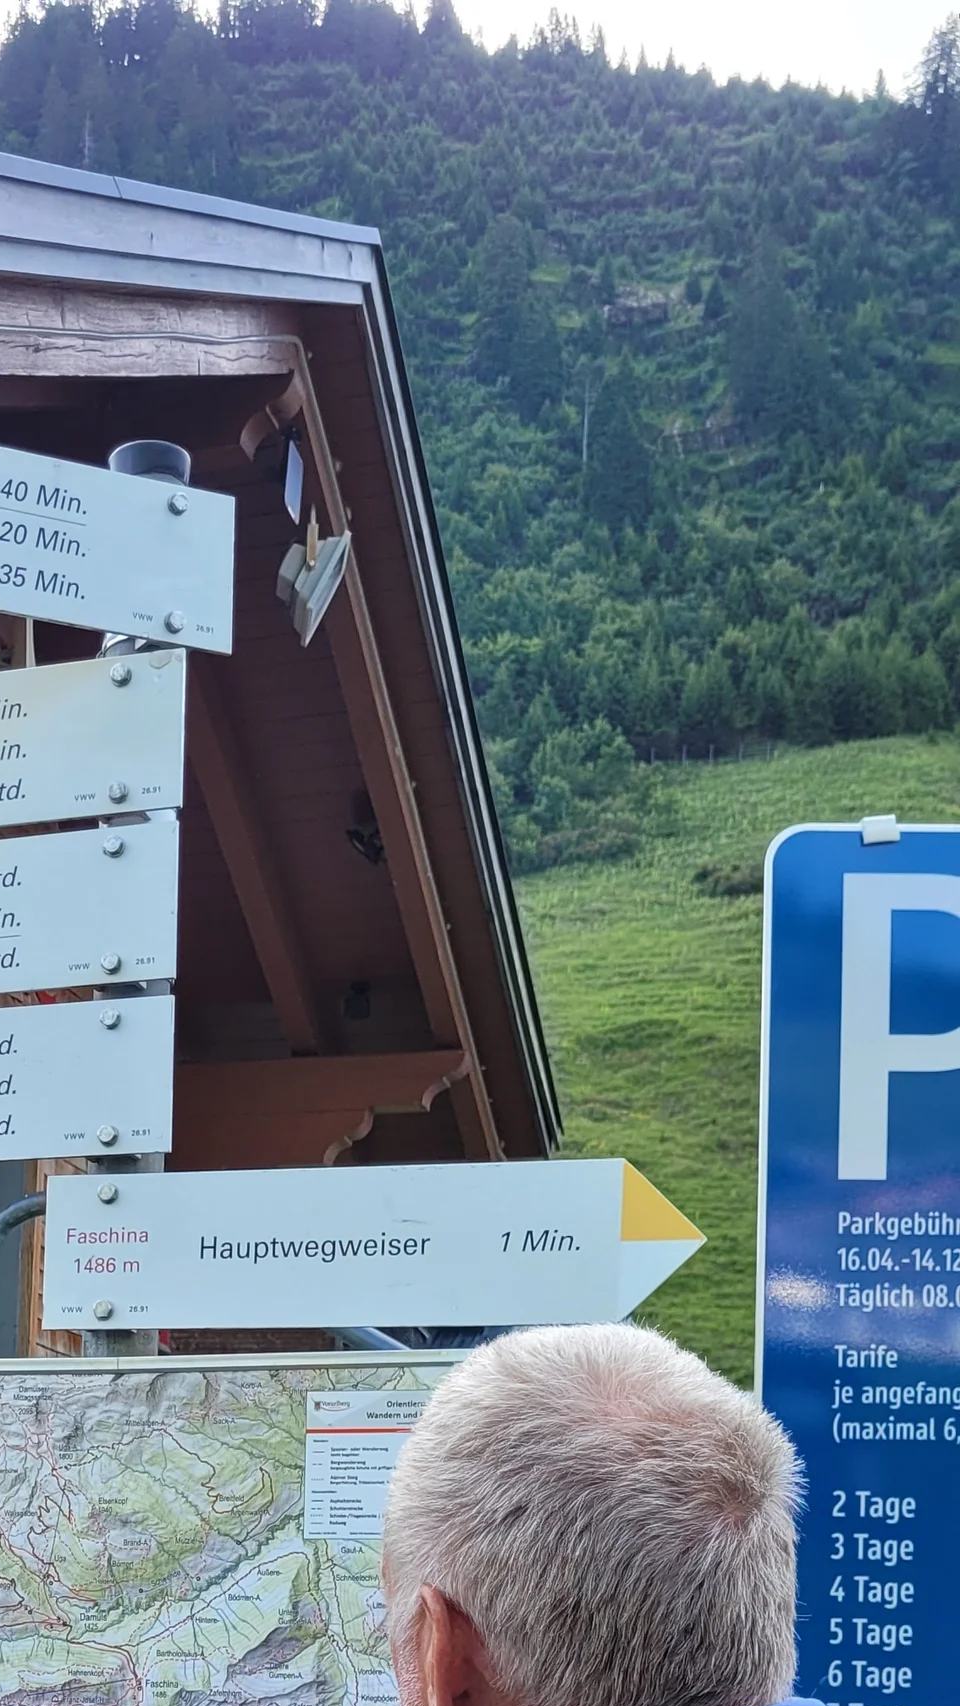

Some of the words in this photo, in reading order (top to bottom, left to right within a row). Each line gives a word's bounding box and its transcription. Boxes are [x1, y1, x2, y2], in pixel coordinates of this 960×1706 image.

[0, 478, 29, 502] 40
[33, 484, 87, 518] Min.
[35, 526, 86, 558] Min.
[34, 569, 85, 600] Min.
[66, 1226, 149, 1245] Faschina
[200, 1231, 431, 1265] Hauptwegweiser
[521, 1229, 581, 1252] Min.
[74, 1255, 117, 1274] 1486
[836, 1282, 914, 1312] Täglich
[834, 1344, 898, 1368] Tarife
[831, 1379, 853, 1409] je
[832, 1413, 936, 1444] (maximal
[832, 1490, 846, 1517] 2
[855, 1490, 916, 1524] Tage
[830, 1532, 845, 1560] 3
[853, 1533, 915, 1567] Tage
[829, 1575, 845, 1602] 4
[853, 1575, 915, 1609] Tage
[829, 1617, 843, 1645] 5
[852, 1618, 913, 1652] Tage
[146, 1680, 179, 1688] Faschina
[827, 1660, 843, 1687] 6
[851, 1660, 912, 1694] Tage
